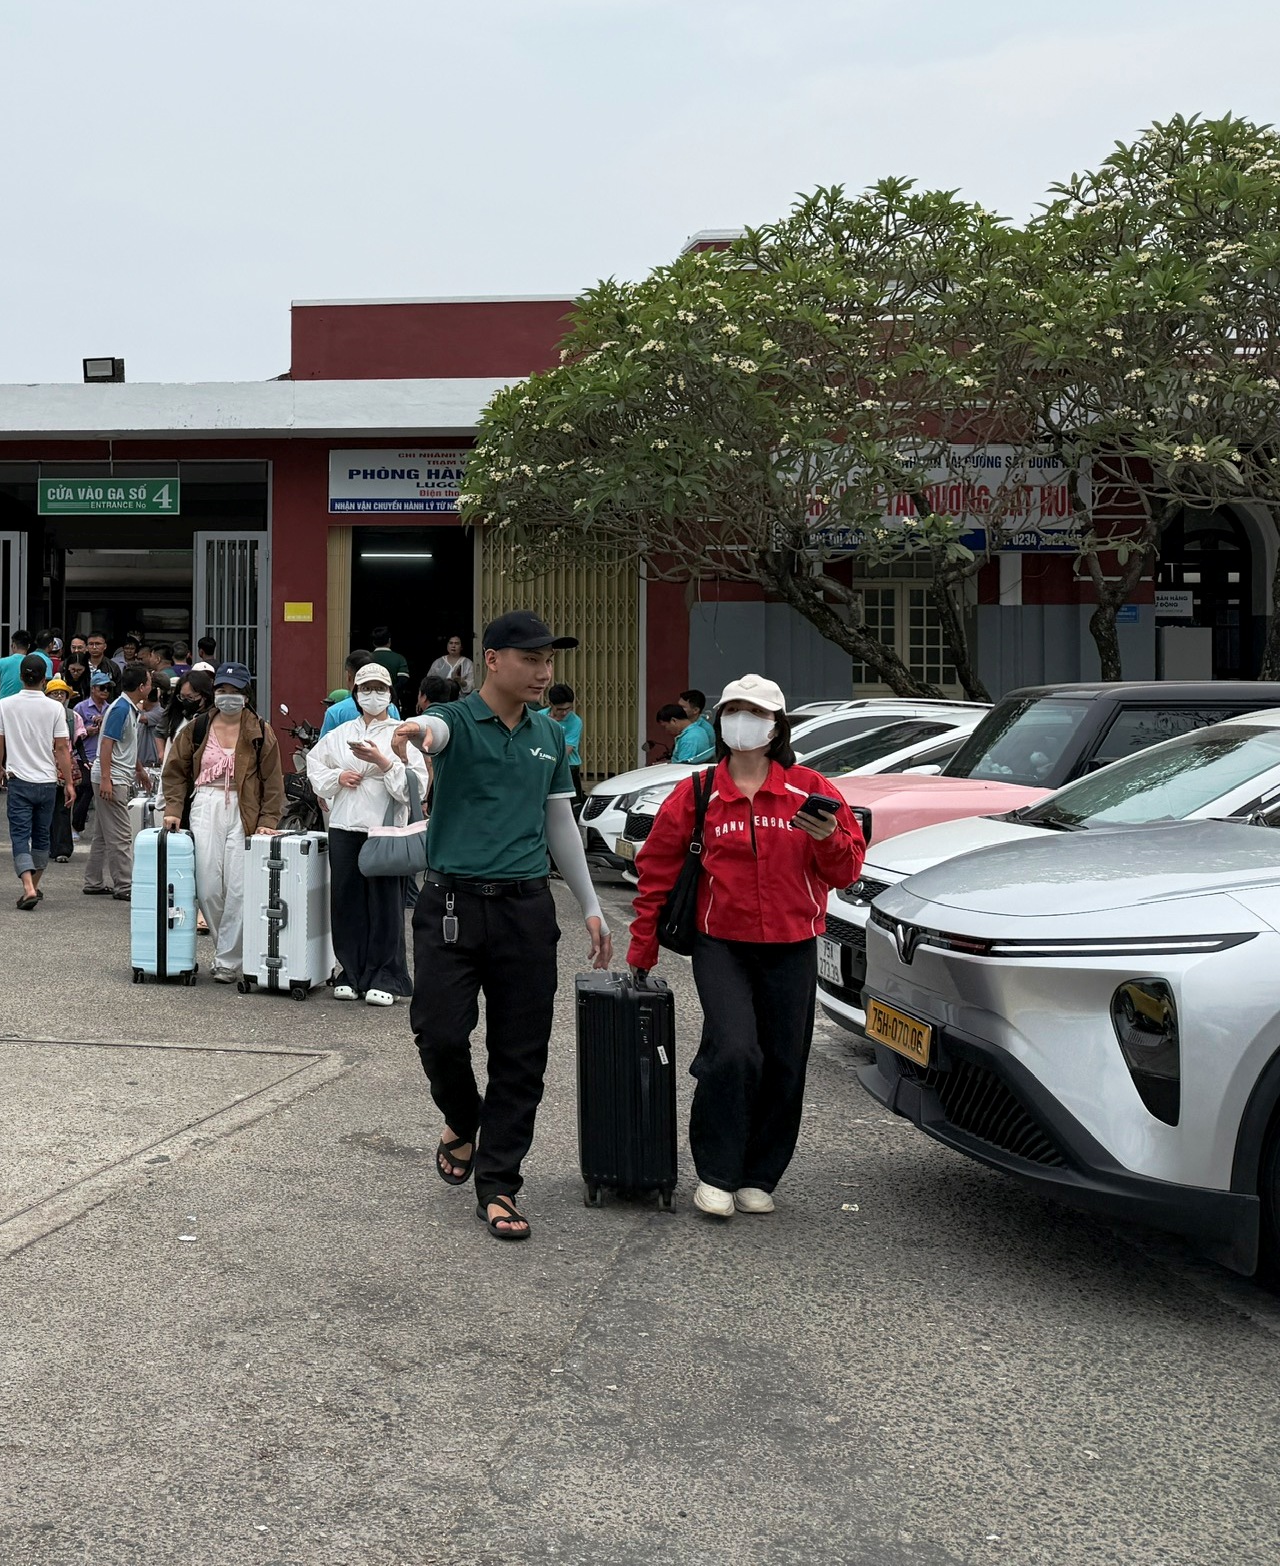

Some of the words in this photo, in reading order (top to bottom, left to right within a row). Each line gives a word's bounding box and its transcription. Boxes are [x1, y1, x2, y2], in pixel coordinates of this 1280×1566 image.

[348, 466, 420, 480] PHÒNG
[427, 466, 468, 480] HÀN
[47, 484, 74, 500] CỬA
[77, 485, 103, 500] VÀO
[107, 487, 125, 500] GA
[128, 483, 147, 500] SỐ
[152, 483, 173, 509] 4
[419, 490, 442, 498] Điện
[90, 501, 133, 509] ENTRANCE
[135, 501, 146, 509] No
[334, 500, 355, 512] NHẬN
[357, 500, 372, 512] VẬN
[403, 500, 424, 511] HÀNH
[1012, 533, 1037, 546] 0234
[872, 1006, 923, 1055] 75H-070.06
